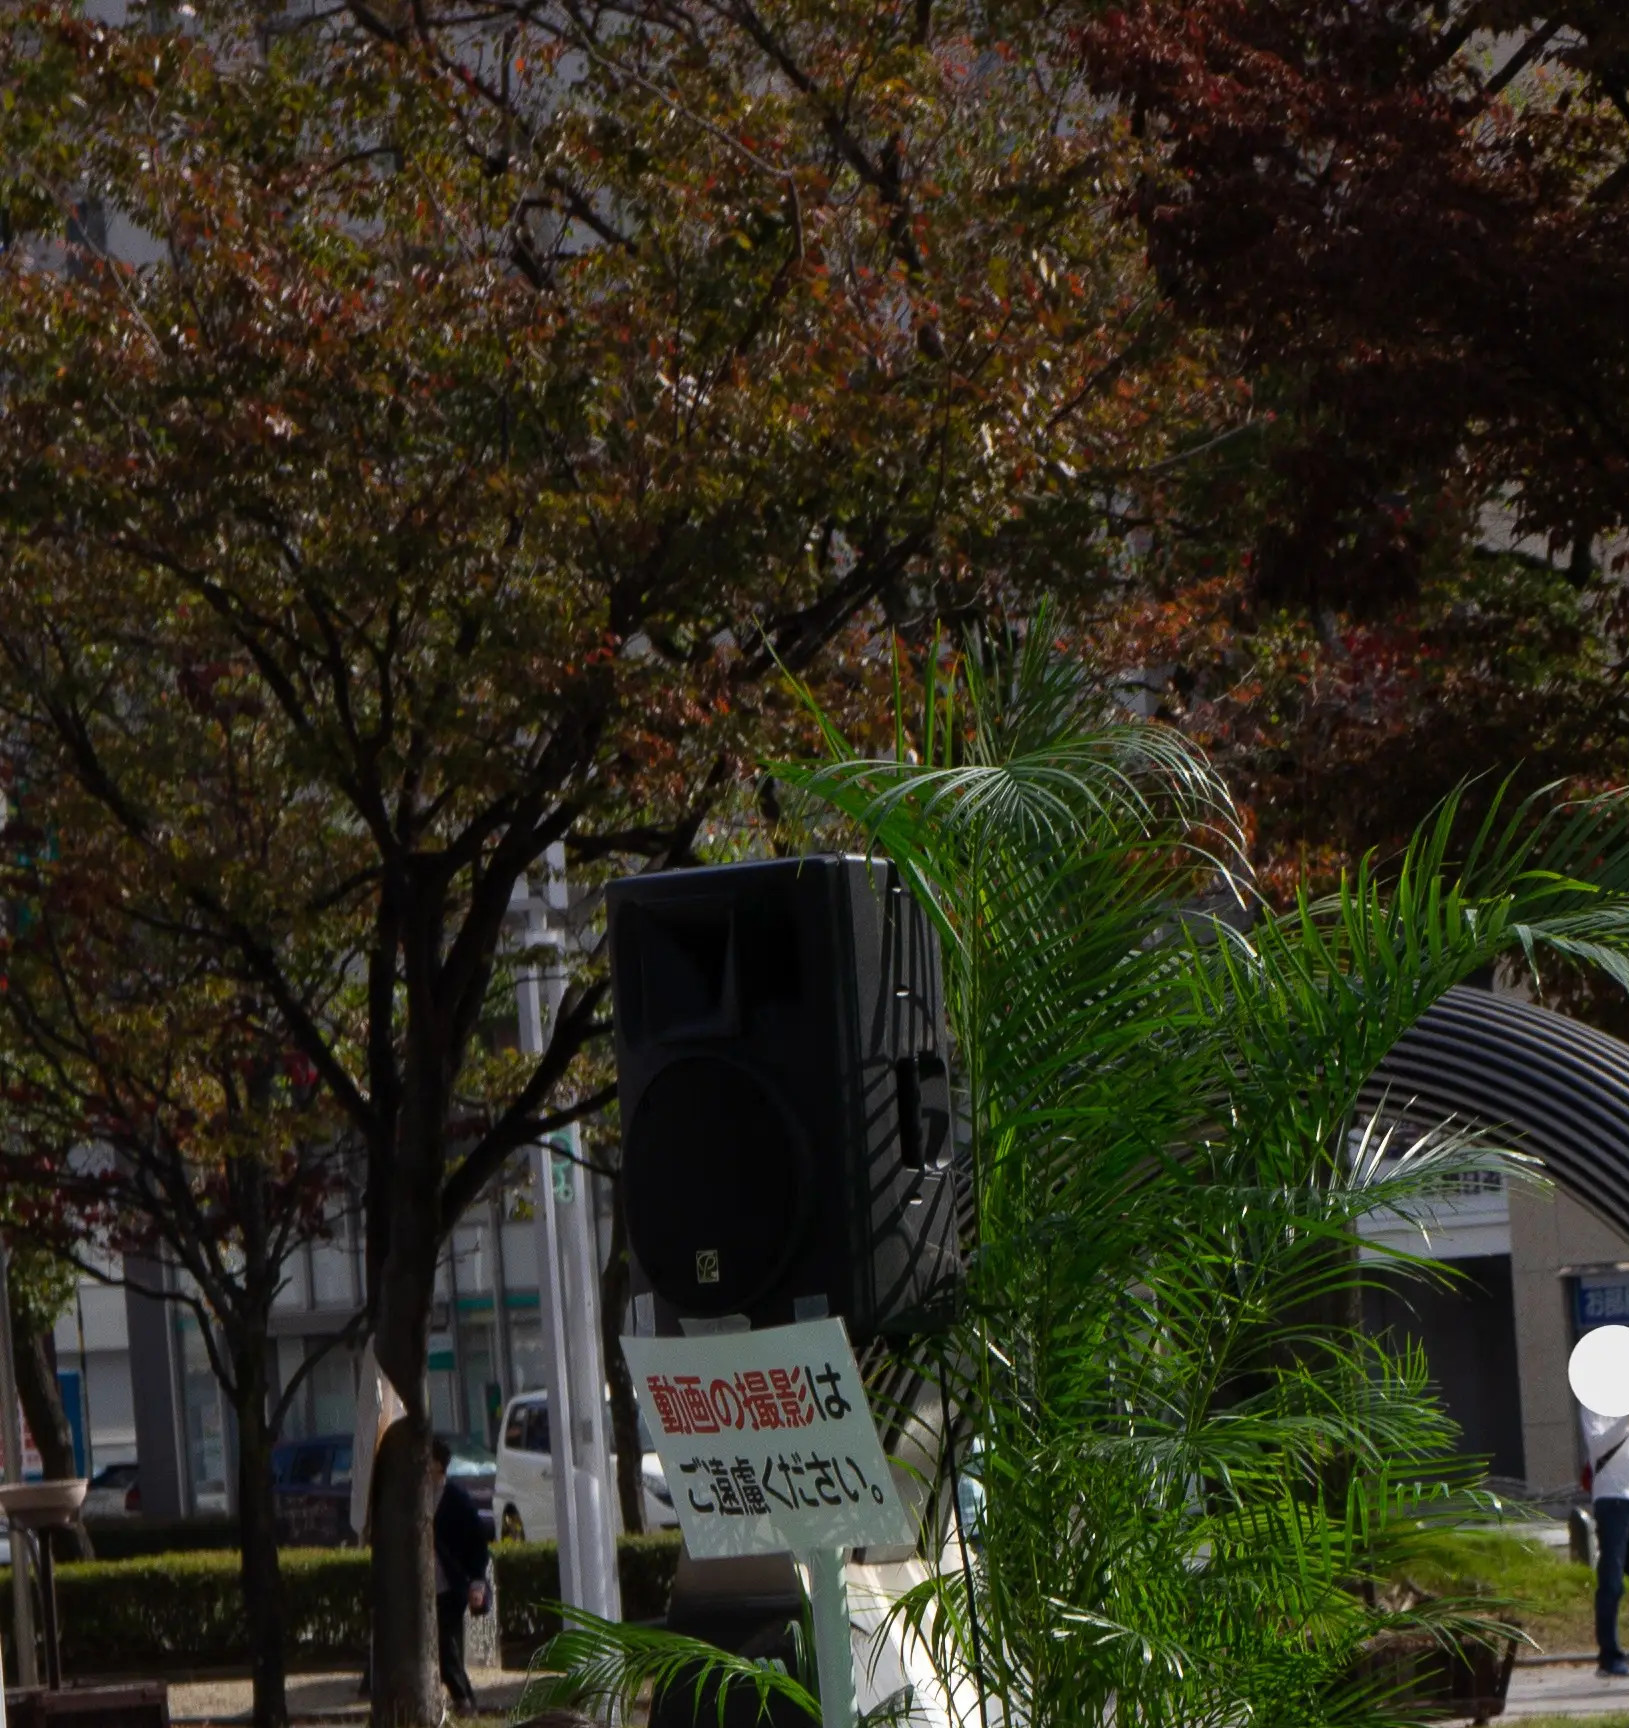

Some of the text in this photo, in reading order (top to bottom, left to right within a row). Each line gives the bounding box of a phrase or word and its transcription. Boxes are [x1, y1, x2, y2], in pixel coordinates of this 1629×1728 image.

[646, 1361, 852, 1436] 動画の撮影は
[679, 1450, 884, 1517] ご遠慮ください。
